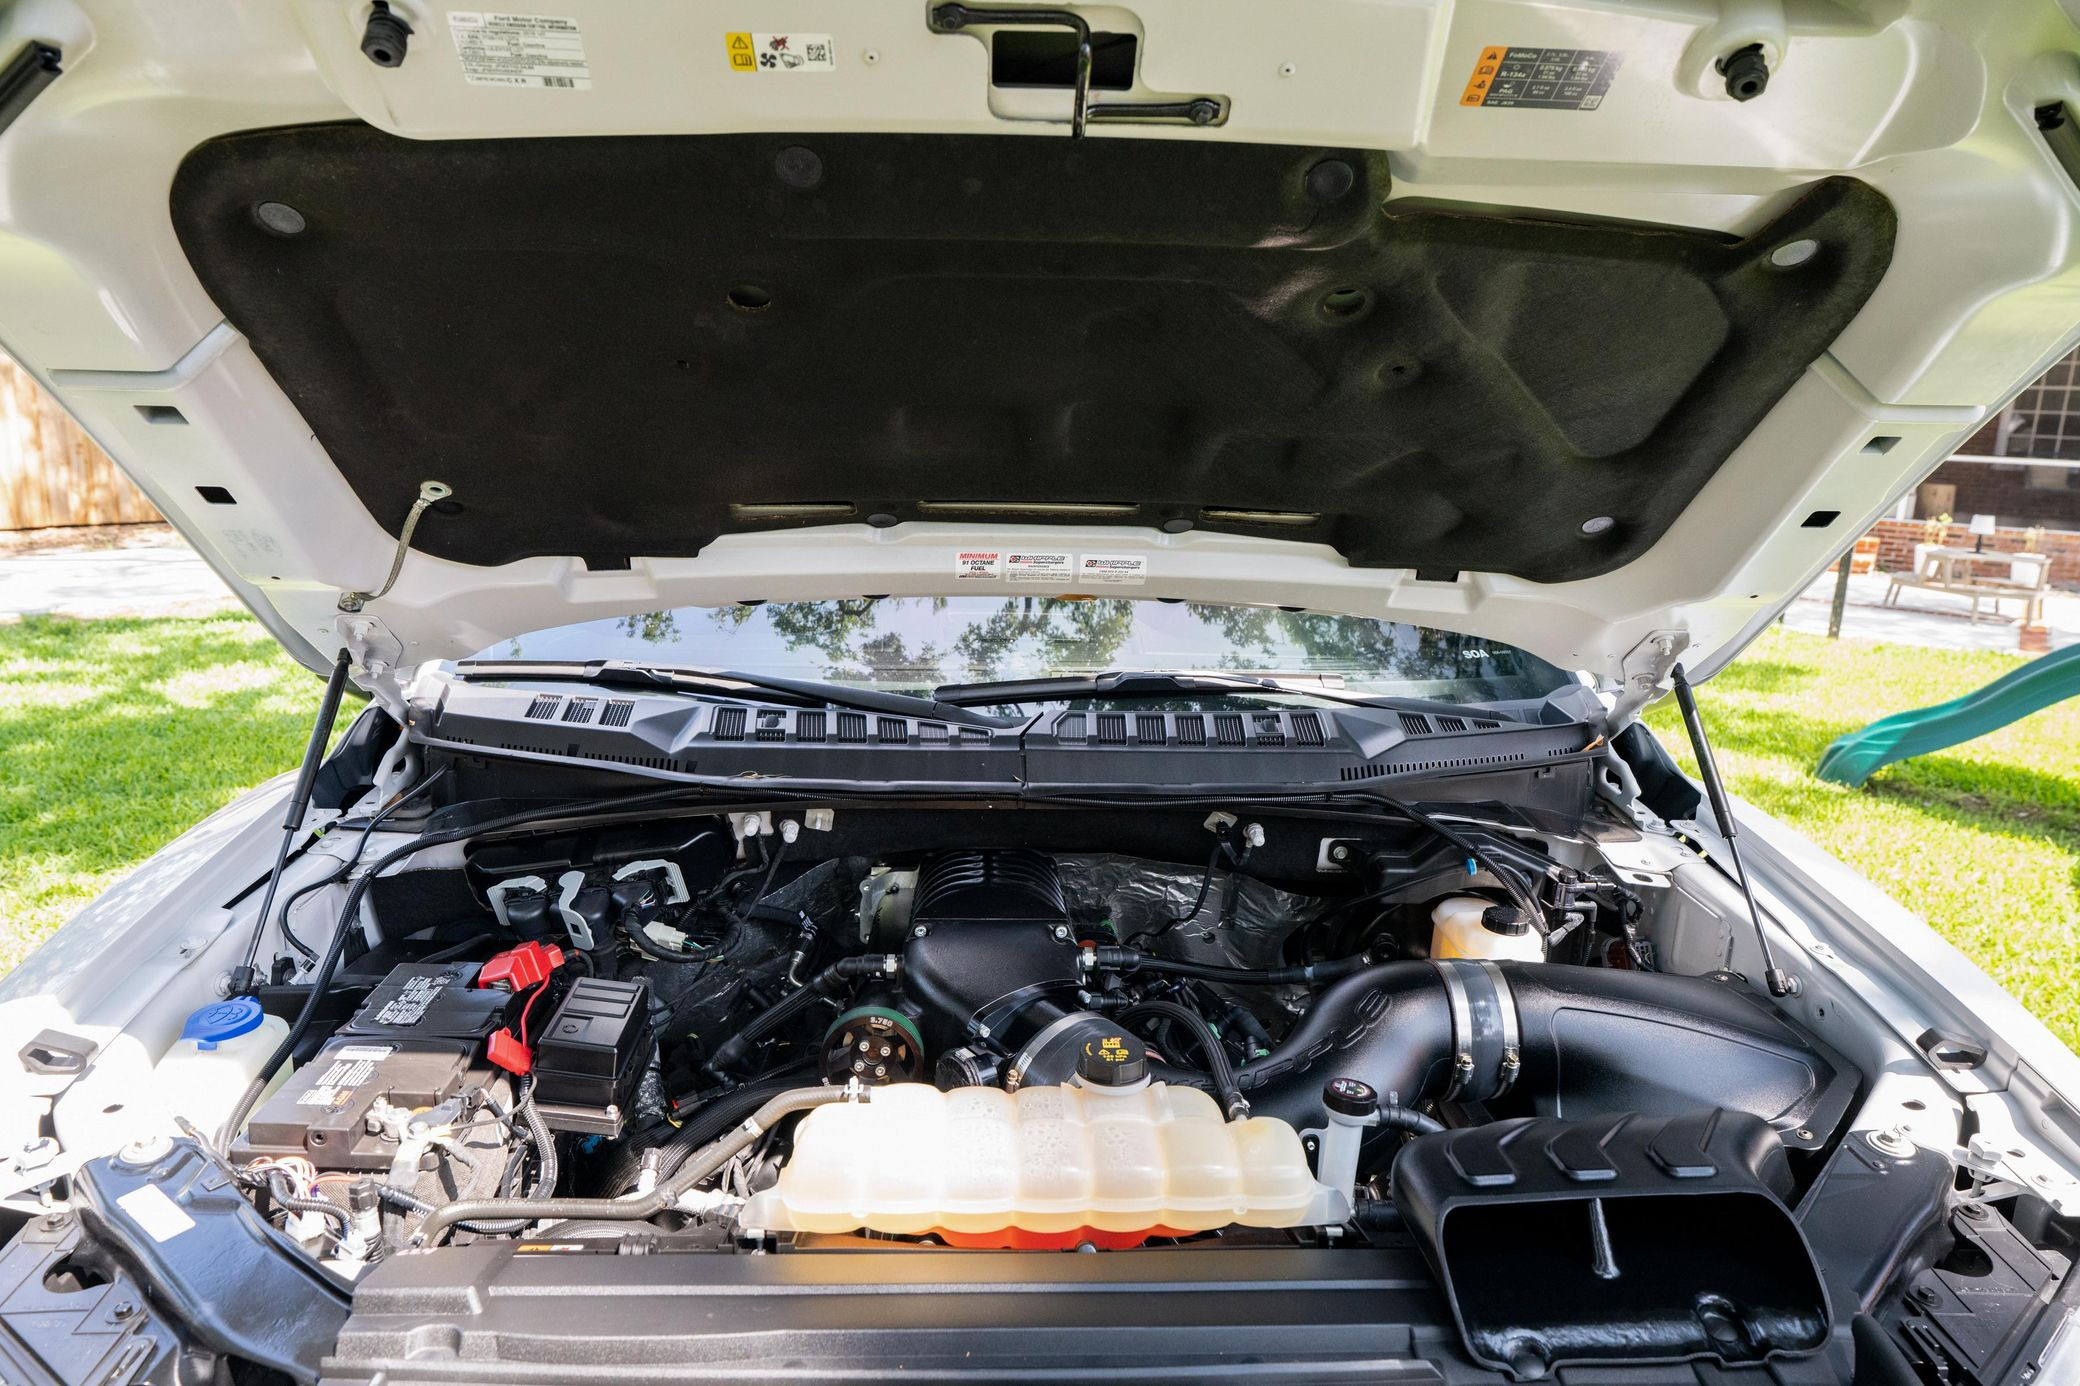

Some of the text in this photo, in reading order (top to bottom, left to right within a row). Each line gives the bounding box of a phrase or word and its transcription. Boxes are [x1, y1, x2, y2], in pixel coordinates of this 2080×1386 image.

[534, 17, 567, 25] Company
[959, 552, 999, 560] MINIMUM
[1462, 649, 1490, 660] SOA
